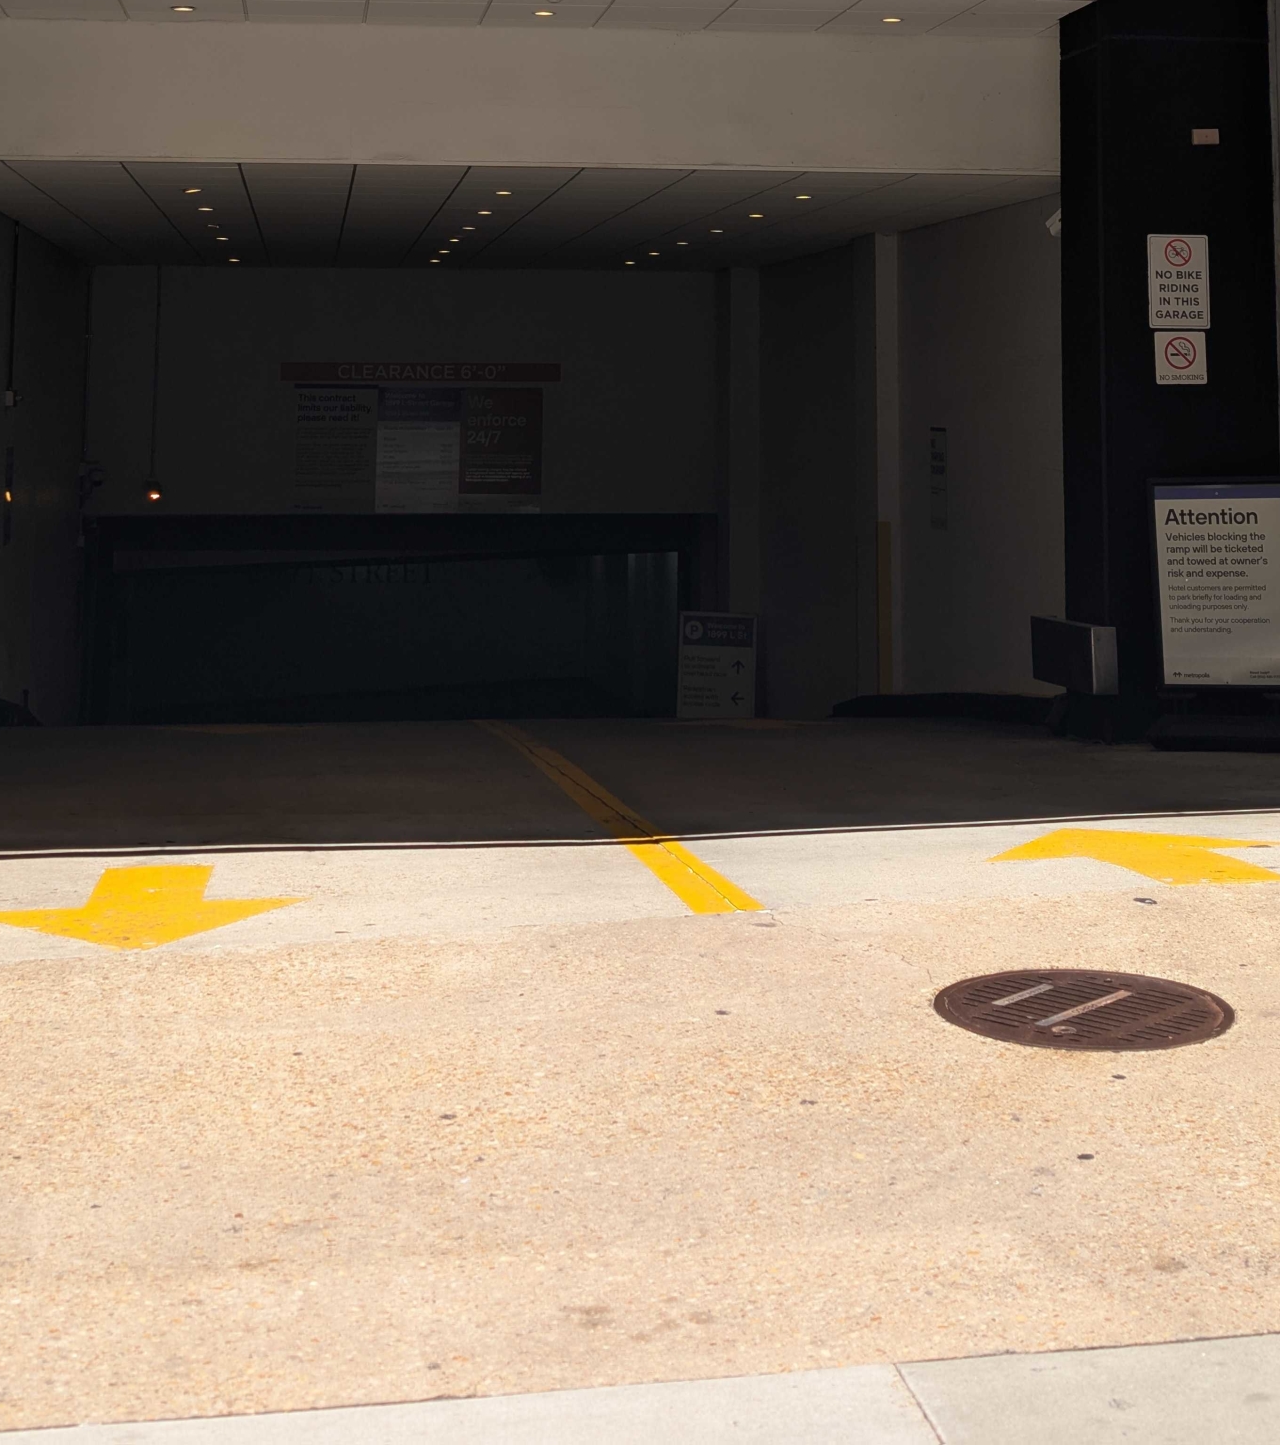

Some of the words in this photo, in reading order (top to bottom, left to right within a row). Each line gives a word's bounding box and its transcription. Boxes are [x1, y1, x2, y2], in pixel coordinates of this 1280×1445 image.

[1156, 270, 1172, 280] NO
[1176, 270, 1202, 280] BIKE
[1159, 284, 1199, 293] RIDING
[1159, 297, 1171, 306] IN
[1174, 297, 1200, 306] THIS
[1156, 310, 1204, 320] GARAGE
[337, 365, 455, 380] CLEARANCE
[298, 393, 317, 402] This
[318, 393, 356, 402] contract
[467, 395, 493, 409] We
[297, 404, 322, 412] limits
[297, 414, 327, 423] please
[328, 414, 349, 422] read
[467, 413, 527, 427] enforce
[467, 430, 501, 446] 24/7
[1165, 508, 1259, 526] Attention
[1165, 532, 1206, 542] Vehicles
[1207, 532, 1248, 545] blocking
[1250, 532, 1266, 541] the
[1166, 546, 1191, 556] ramp
[1192, 544, 1208, 554] will
[1210, 544, 1222, 554] be
[1224, 544, 1264, 553] ticketed
[1167, 557, 1185, 566] and
[1186, 557, 1217, 566] towed
[1218, 557, 1229, 566] at
[1231, 556, 1268, 566] owner's
[1167, 569, 1184, 578] risk
[1186, 569, 1204, 578] and
[1206, 570, 1248, 580] expense.
[1168, 584, 1186, 592] Hotel
[1234, 584, 1266, 593] permitted
[1177, 594, 1191, 602] park
[1192, 593, 1212, 602] briefly
[1213, 593, 1222, 601] for
[1224, 593, 1248, 602] loading
[1169, 603, 1201, 612] unloading
[1202, 604, 1233, 612] purposes
[1234, 603, 1249, 612] only.
[1191, 618, 1203, 626] you
[1215, 618, 1230, 626] your
[1231, 617, 1270, 626] cooperation
[707, 630, 727, 639] 1899
[1184, 626, 1232, 634] understanding.
